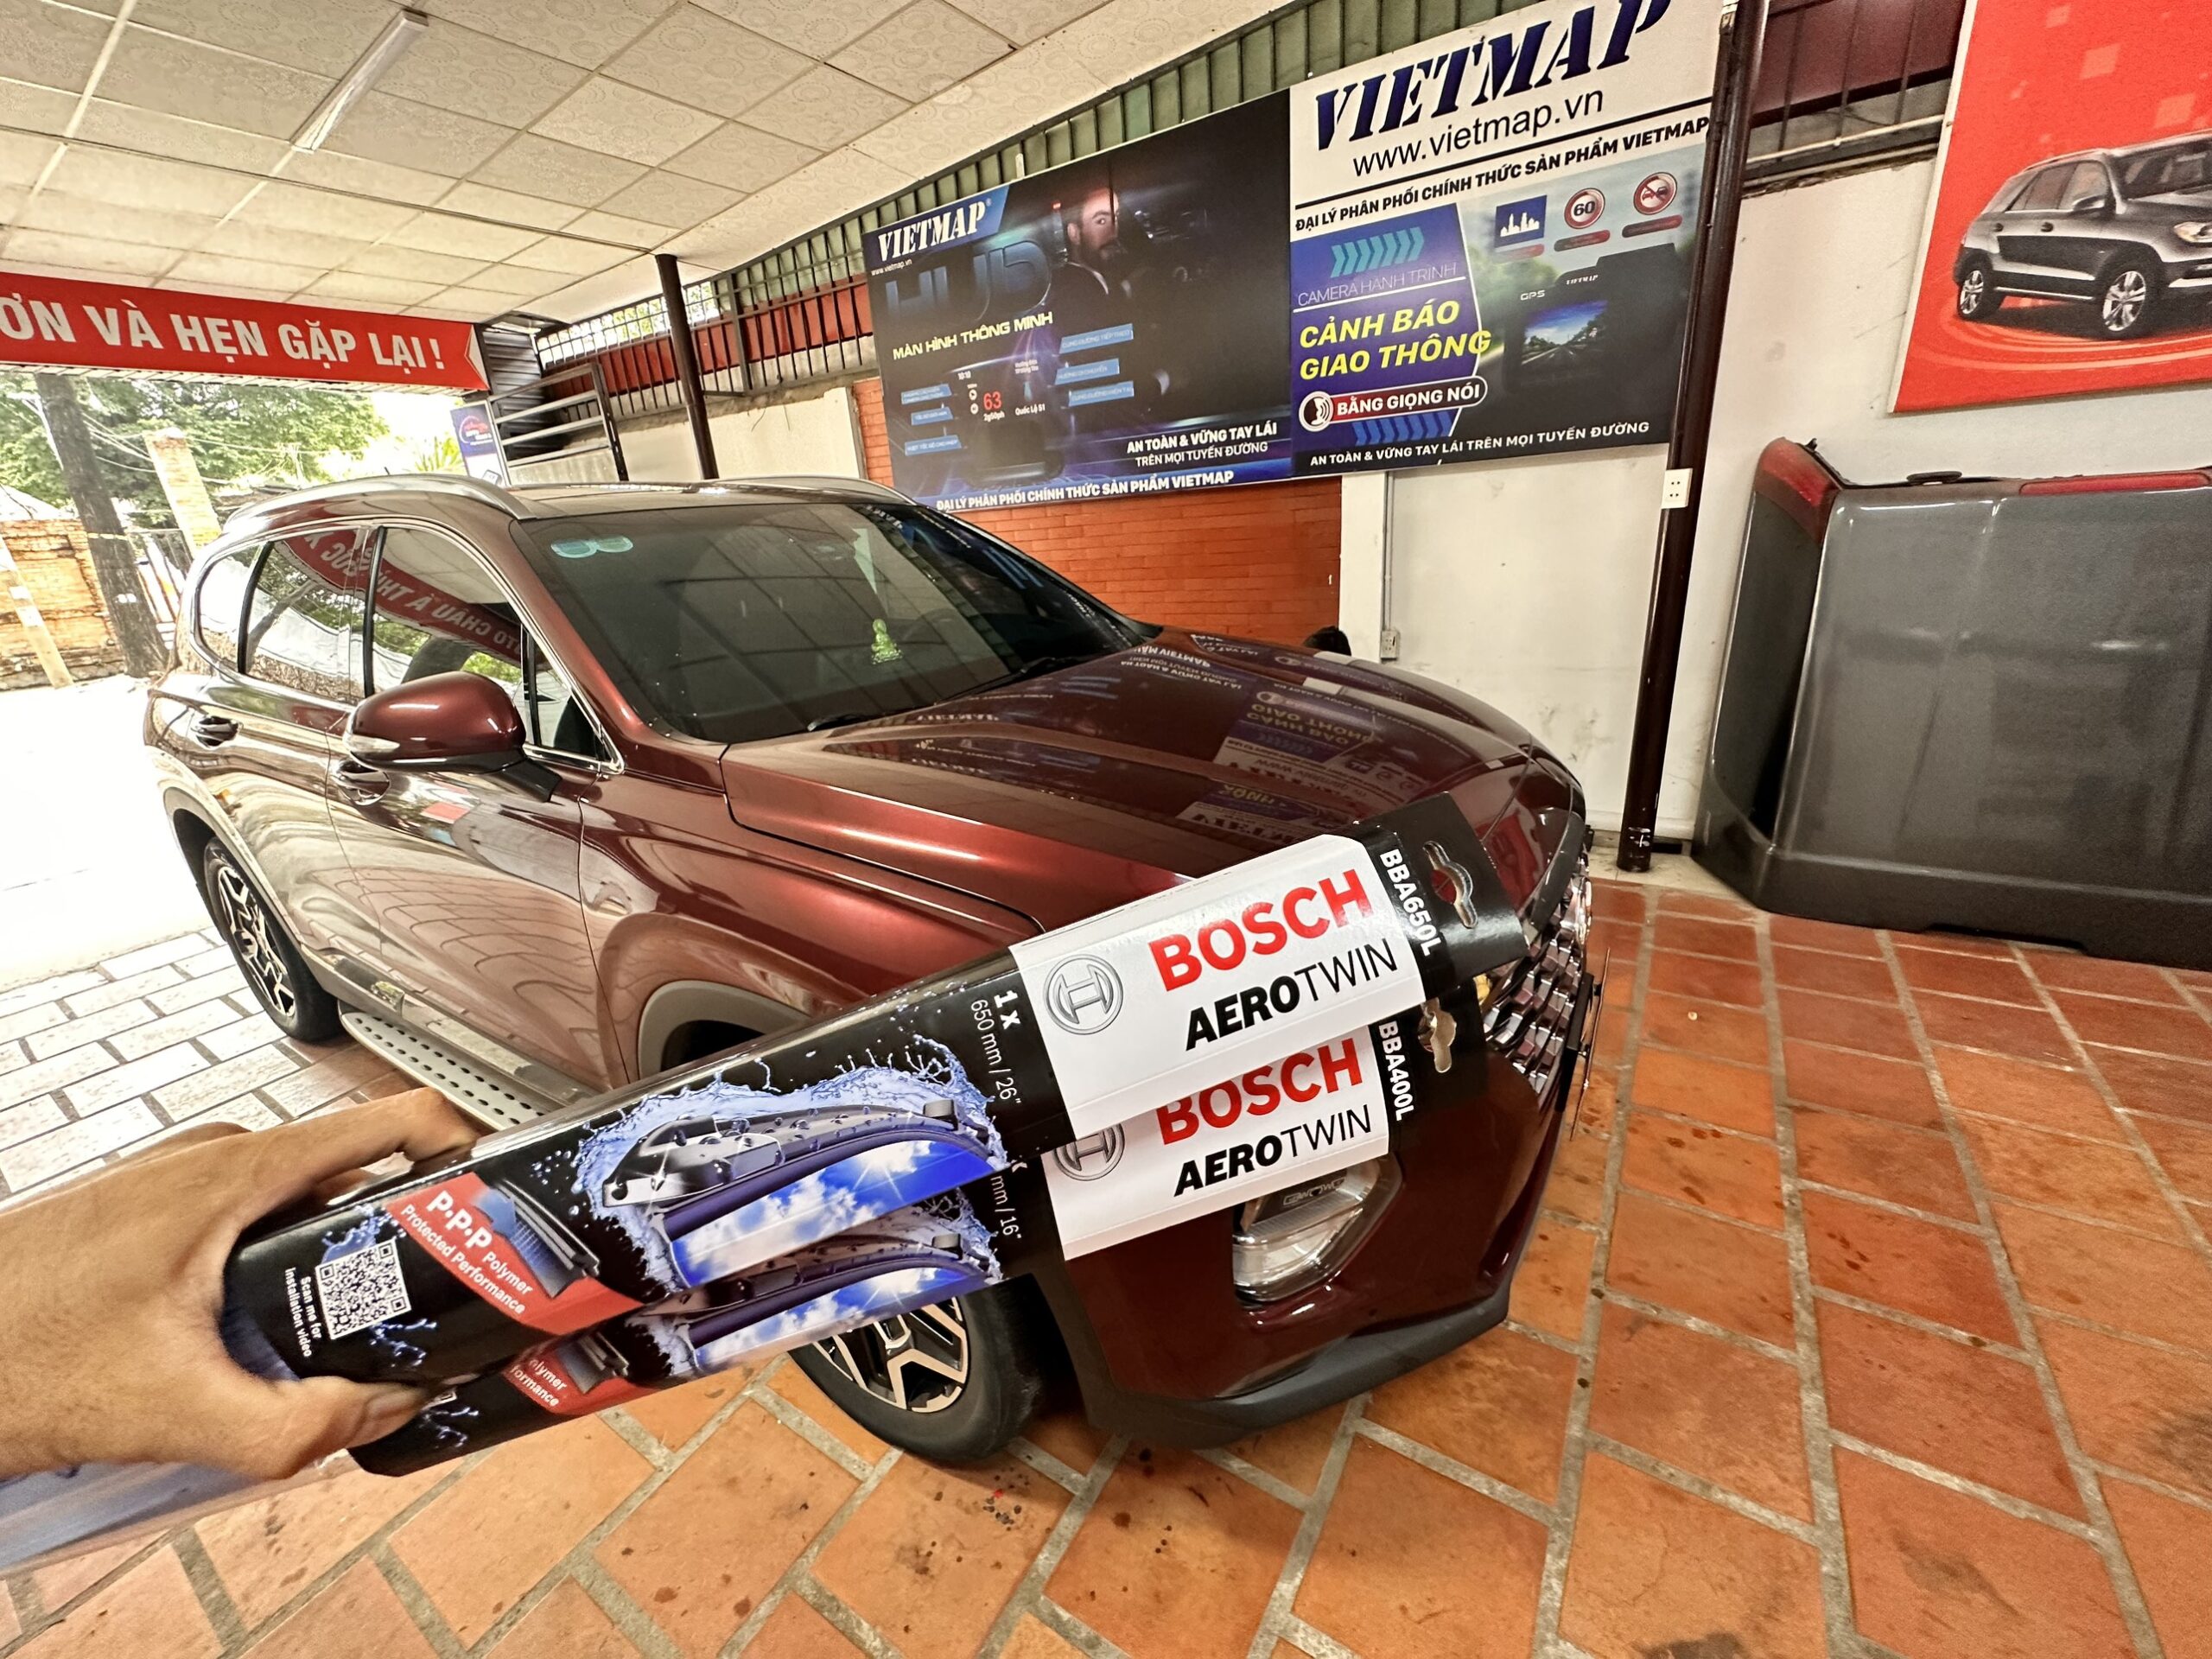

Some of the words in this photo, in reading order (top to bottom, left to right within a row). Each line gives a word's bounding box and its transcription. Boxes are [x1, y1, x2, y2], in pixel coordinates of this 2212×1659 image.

[1316, 0, 1670, 150] VIETMAP
[1353, 89, 1603, 176] www.vietmap.vn
[1296, 215, 1319, 231] ĐẠI
[1322, 207, 1337, 225] LÝ
[1340, 199, 1379, 220] PHÂN
[1382, 187, 1419, 211] PHỐI
[1422, 175, 1471, 200] CHÍNH
[1475, 163, 1522, 187] THỨC
[1564, 137, 1618, 165] PHẨM
[1623, 116, 1709, 150] VIETMAP
[878, 200, 986, 261] VIETMAP
[1573, 200, 1596, 216] 60
[871, 258, 912, 276] www.vietmap.vn
[1298, 283, 1357, 306] CAMERA
[1520, 289, 1545, 301] GPS
[0, 292, 77, 342] ƠN
[82, 298, 164, 349] VÀ
[169, 314, 269, 363] HẸN
[277, 319, 356, 369] GẶP
[893, 340, 923, 359] MÀN
[925, 334, 957, 353] HÌNH
[960, 323, 1010, 344] THÔNG
[1014, 311, 1053, 331] MINH
[1300, 315, 1386, 348] CẢNH
[1391, 298, 1460, 334] BÁO
[1300, 350, 1370, 381] GIAO
[1378, 330, 1492, 369] THÔNG
[983, 391, 1002, 410] 63
[1337, 397, 1383, 416] BẰNG
[1386, 391, 1443, 410] GIỌNG
[1447, 383, 1480, 402] NÓI
[1127, 440, 1144, 454] AN
[1146, 434, 1178, 450] TOÀN
[1179, 435, 1188, 446] &
[1190, 429, 1227, 445] VỮNG
[1229, 425, 1254, 440] TAY
[1255, 420, 1277, 436] LÁI
[1135, 452, 1163, 467] TRÊN
[1164, 452, 1186, 465] MỌI
[1187, 445, 1223, 461] TUYẾN
[1224, 441, 1268, 457] ĐƯỜNG
[1310, 455, 1327, 466] AN
[1329, 451, 1362, 463] TOÀN
[1364, 452, 1373, 461] &
[1376, 447, 1413, 460] VỮNG
[1415, 444, 1440, 455] TAY
[1442, 440, 1464, 454] LÁI
[1466, 436, 1503, 450] TRÊN
[1506, 434, 1534, 447] MỌI
[1537, 426, 1586, 442] TUYẾN
[1590, 422, 1649, 436] ĐƯỜNG
[955, 496, 967, 508] LÝ
[968, 493, 998, 508] PHÂN
[999, 488, 1026, 505] PHỐI
[1027, 486, 1065, 502] CHÍNH
[1065, 482, 1100, 498] THỨC
[1130, 473, 1169, 493] PHẨM
[1172, 470, 1234, 489] VIETMAP
[1380, 849, 1441, 957] BBA650L
[1148, 868, 1374, 992] BOSCH
[971, 1000, 995, 1031] 650
[1185, 938, 1398, 1051] AEROTWIN
[981, 1033, 1001, 1065] mm
[1379, 1020, 1414, 1121] BBA400L
[1156, 1038, 1363, 1145] BOSCH
[1173, 1104, 1371, 1197] AEROTWIN
[990, 1175, 1008, 1205] mm
[401, 1204, 456, 1257] Protected
[451, 1251, 525, 1314] Performance
[482, 1251, 533, 1295] Polymer
[285, 1267, 303, 1328] Installation
[296, 1328, 312, 1357] video
[302, 1276, 313, 1304] Scan
